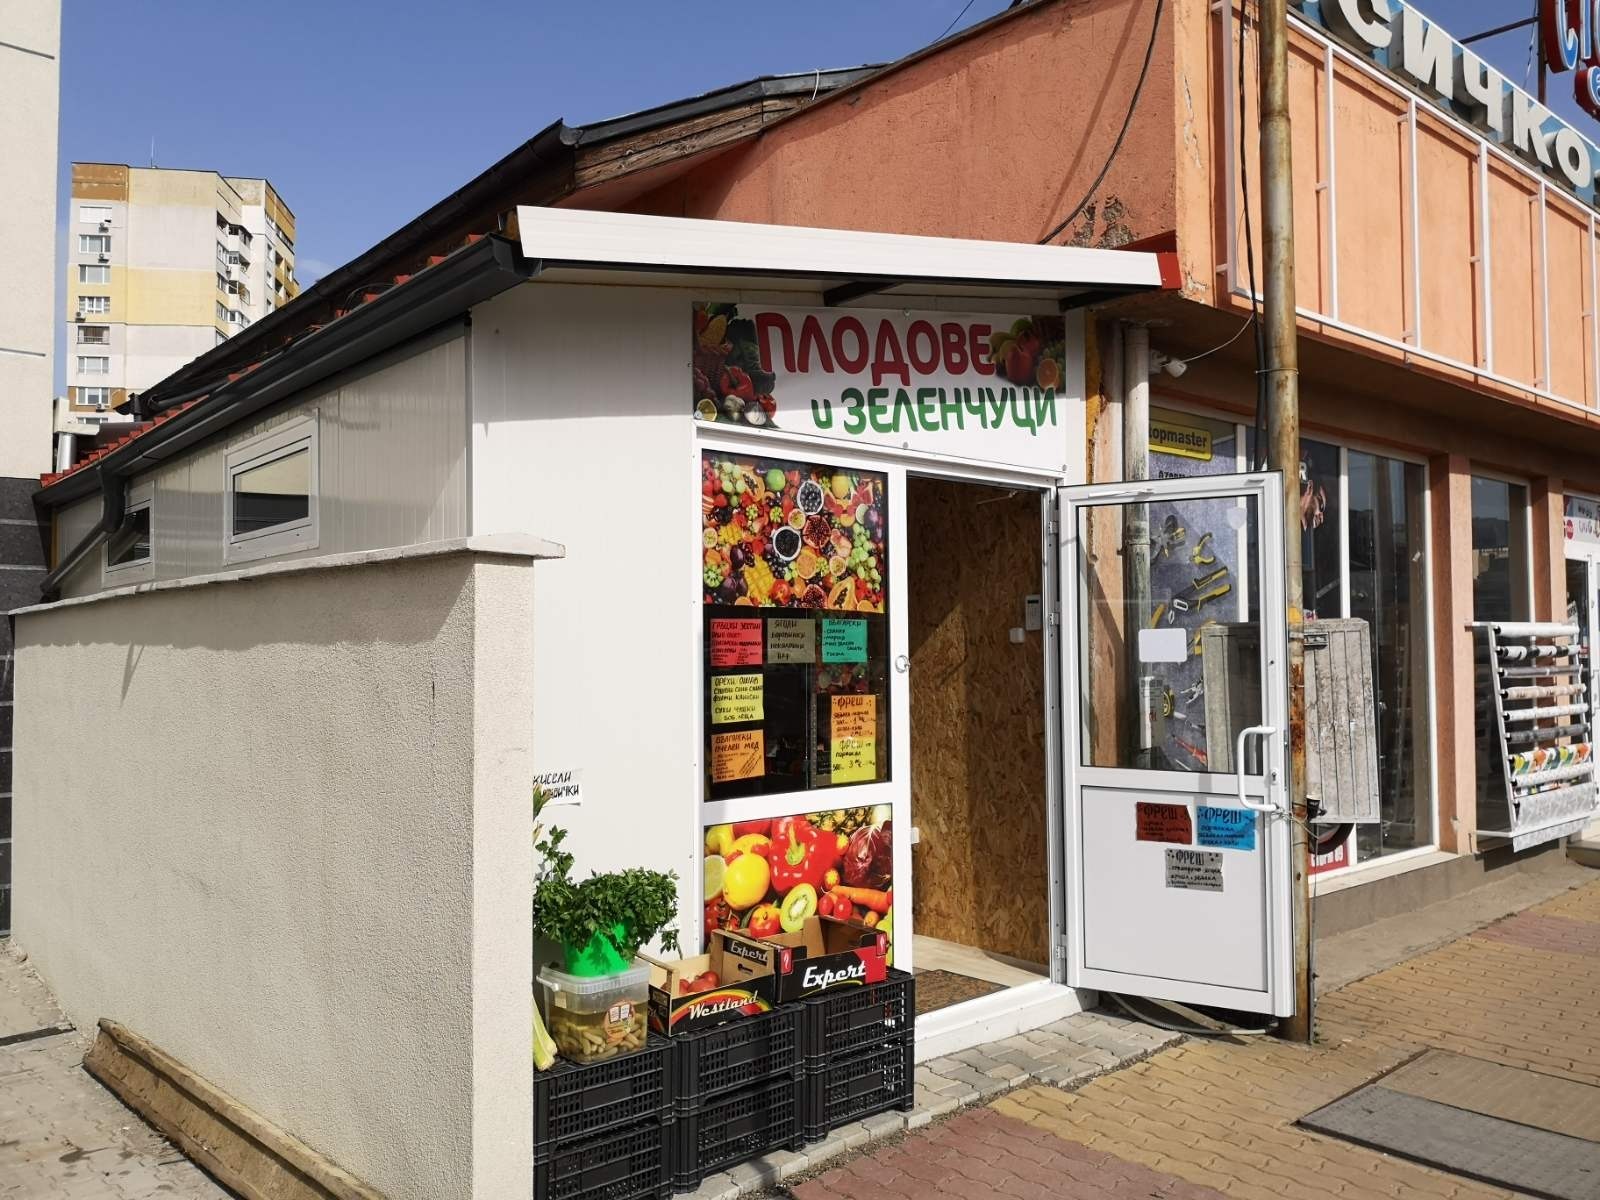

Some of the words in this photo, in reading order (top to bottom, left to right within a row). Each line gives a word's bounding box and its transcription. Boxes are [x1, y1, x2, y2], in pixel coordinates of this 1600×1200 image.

[755, 312, 996, 386] ПЛОДОВЕ
[841, 387, 1057, 436] ЗЕЛЕНЧУЦИ
[802, 960, 866, 989] Expert
[688, 990, 759, 1021] Westland
